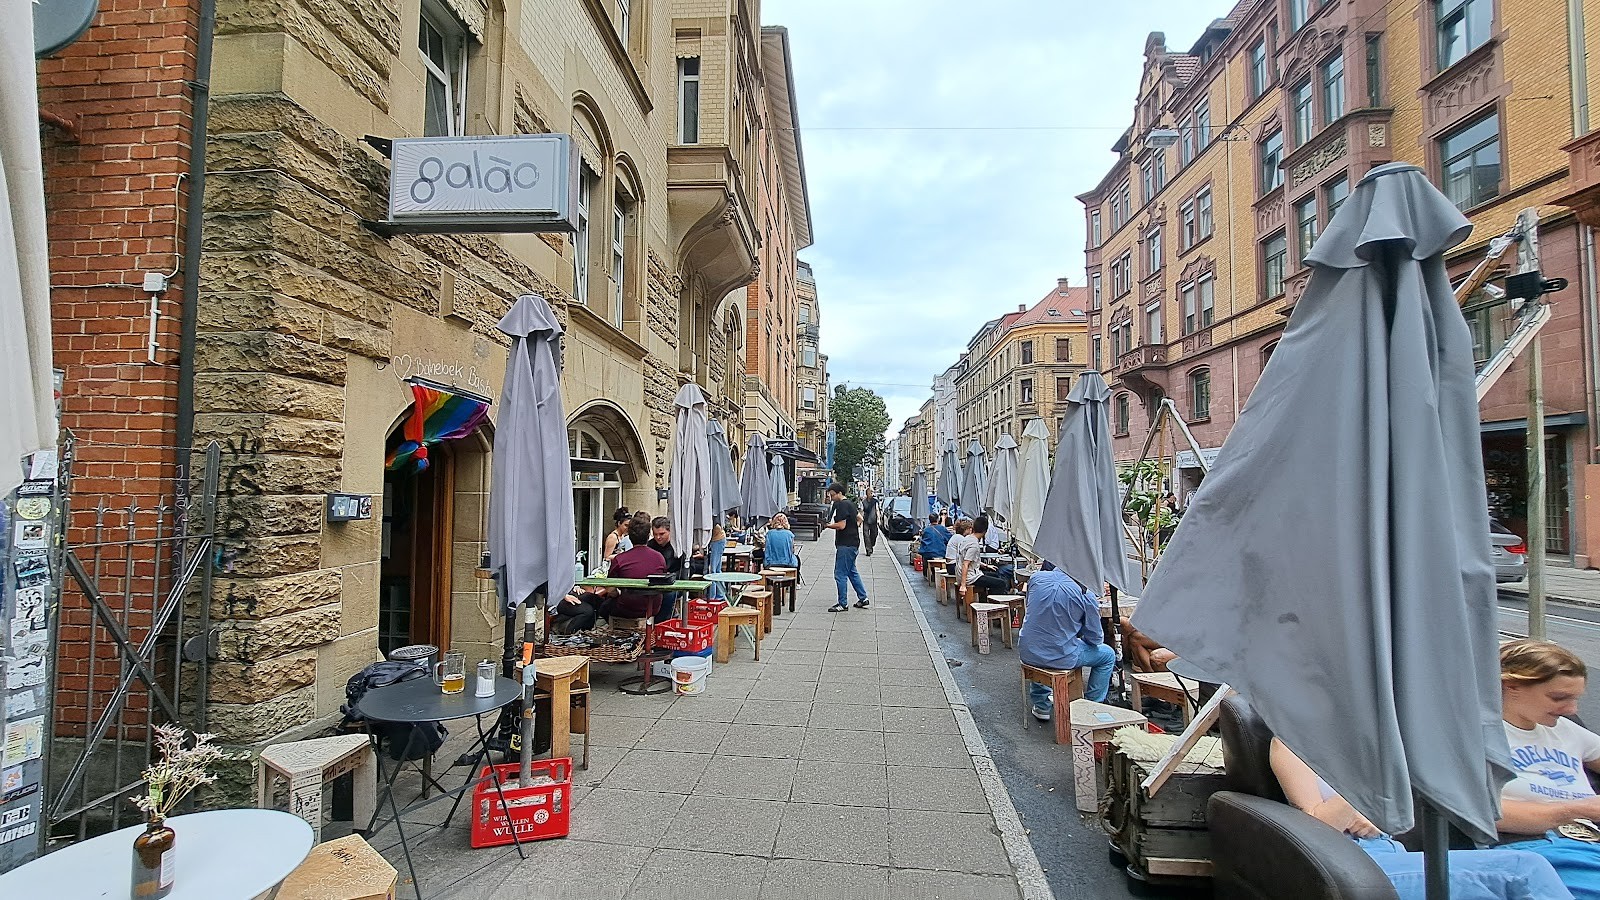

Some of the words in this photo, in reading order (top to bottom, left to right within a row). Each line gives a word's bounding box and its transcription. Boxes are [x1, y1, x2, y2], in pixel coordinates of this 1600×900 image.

[1529, 783, 1569, 799] RACQUET
[500, 818, 530, 826] WLLEN
[493, 823, 534, 836] WULLE
